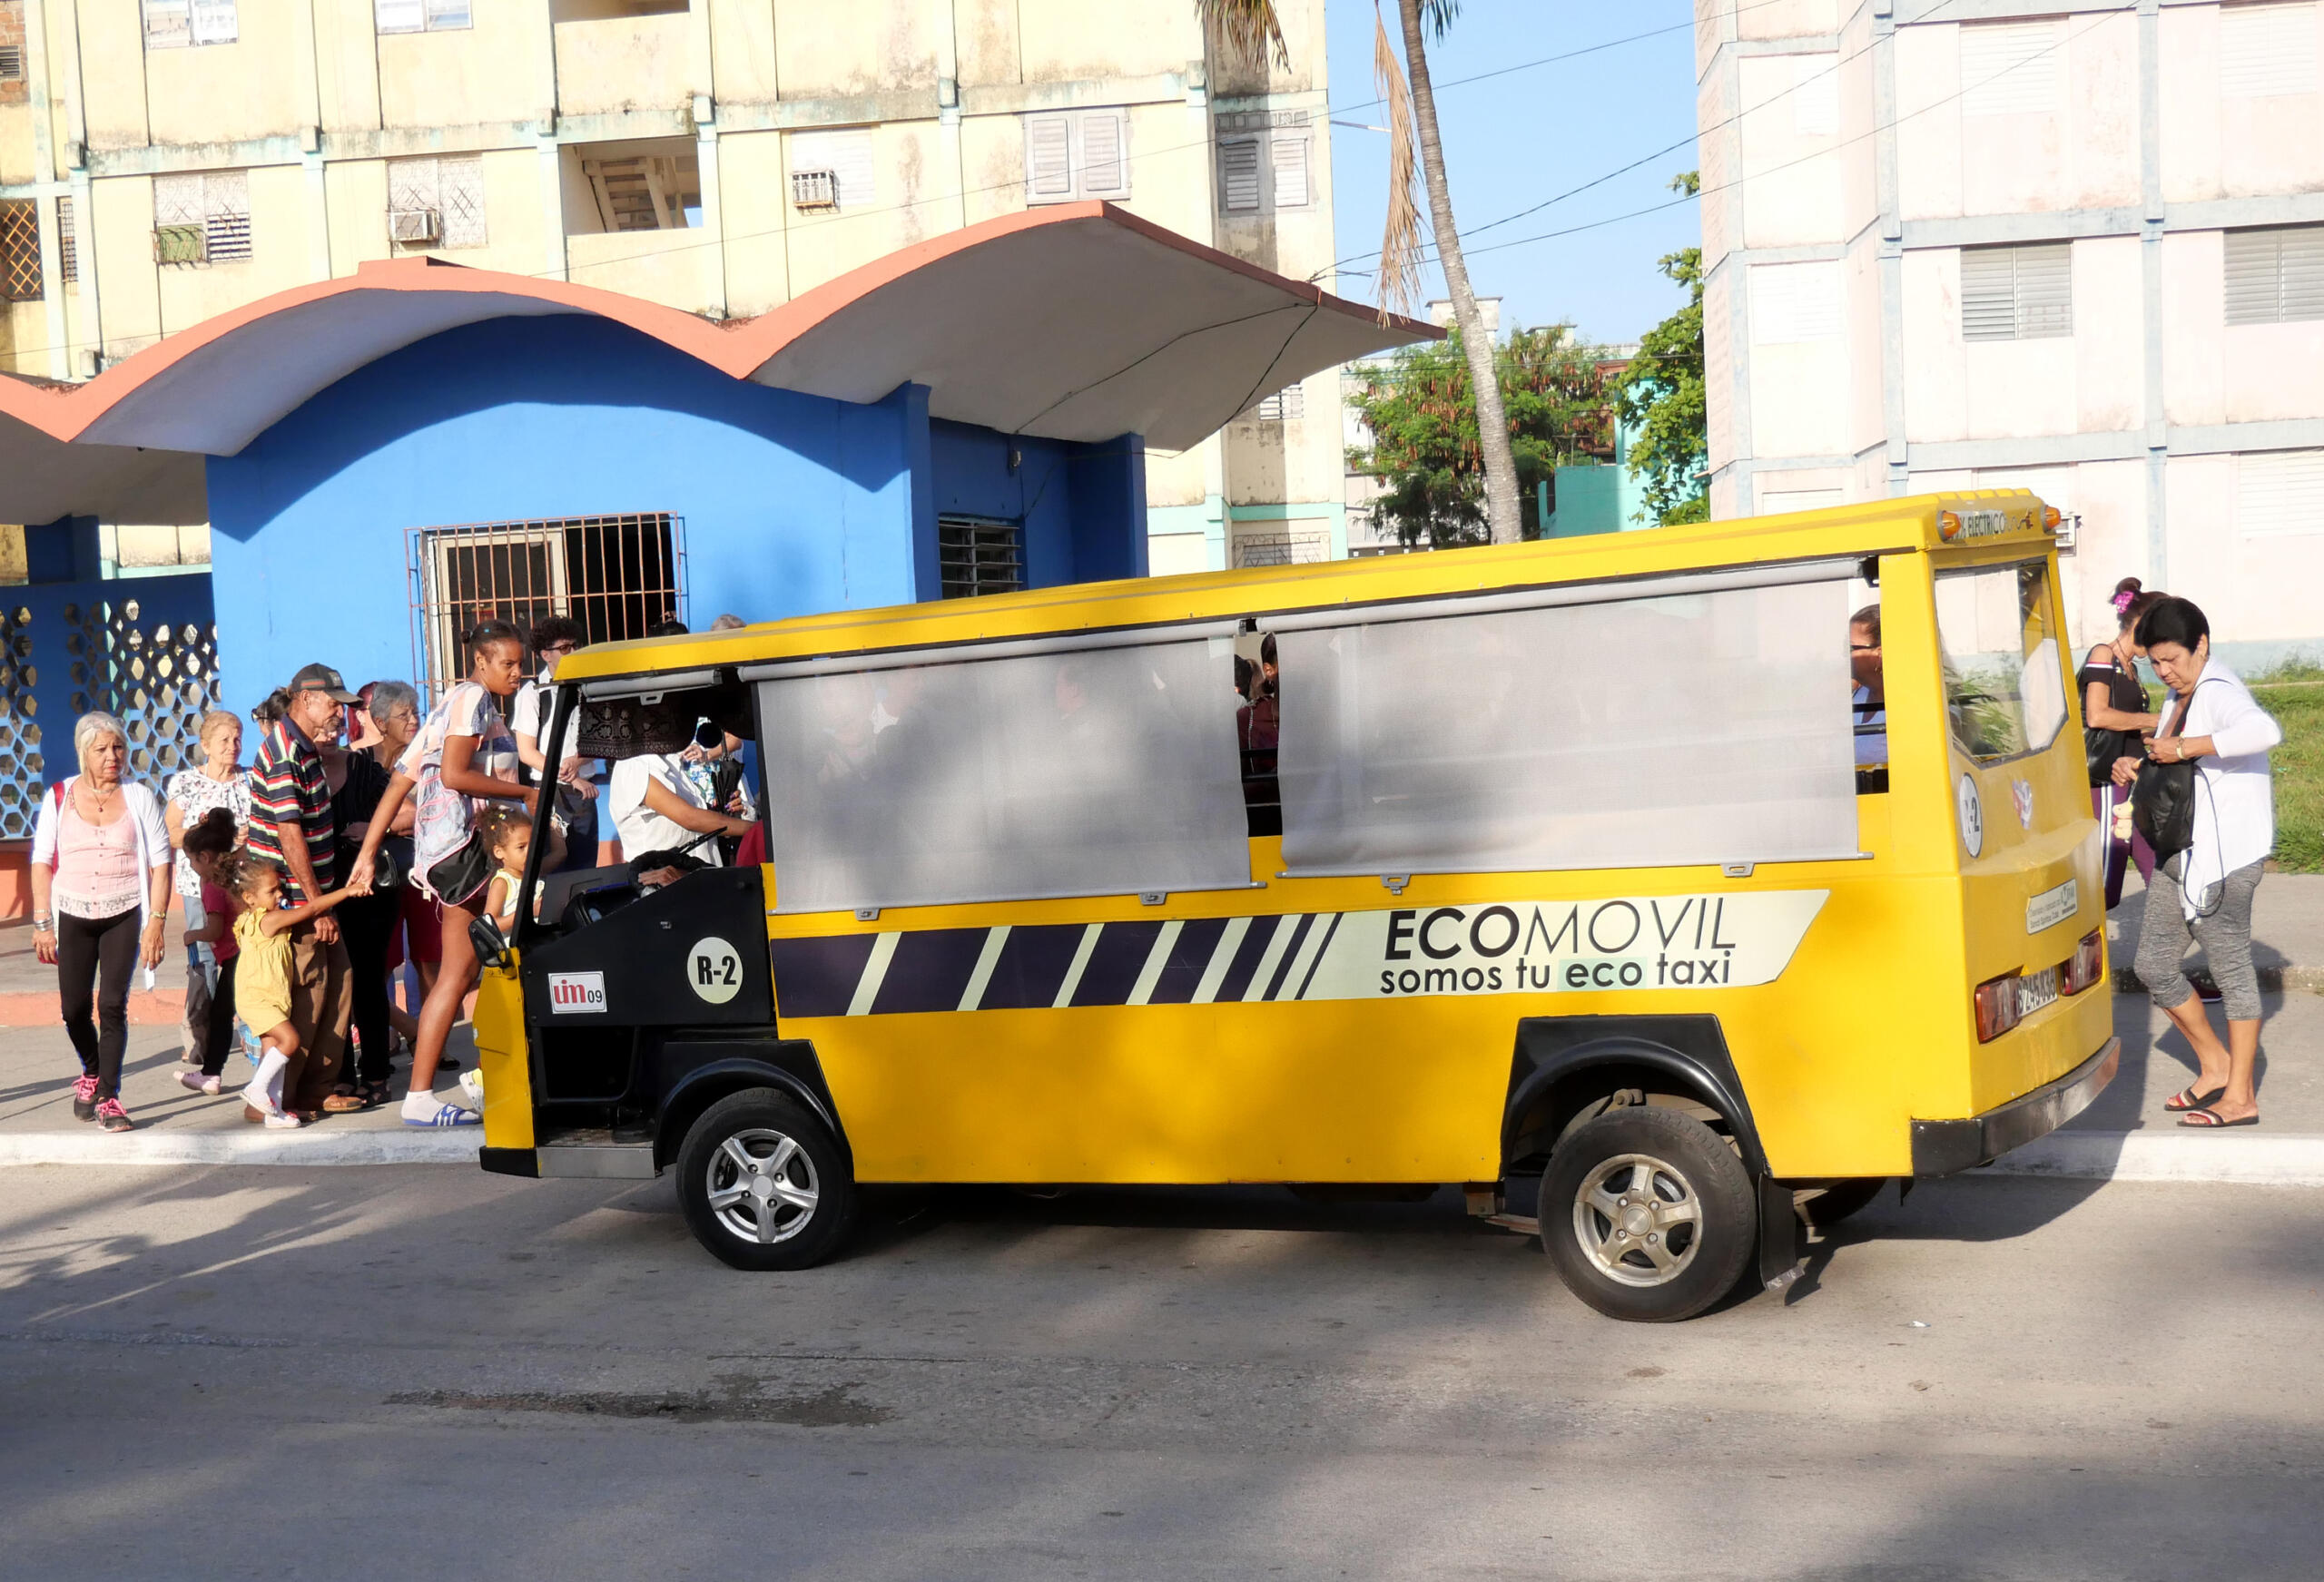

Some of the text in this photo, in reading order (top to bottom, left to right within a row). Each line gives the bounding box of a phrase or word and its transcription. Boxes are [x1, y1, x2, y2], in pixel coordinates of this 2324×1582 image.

[1384, 897, 1736, 961] ECOMOVIL
[696, 955, 737, 986] R-2
[1380, 950, 1731, 995] somos tu eco taxi
[587, 989, 603, 1004] 09
